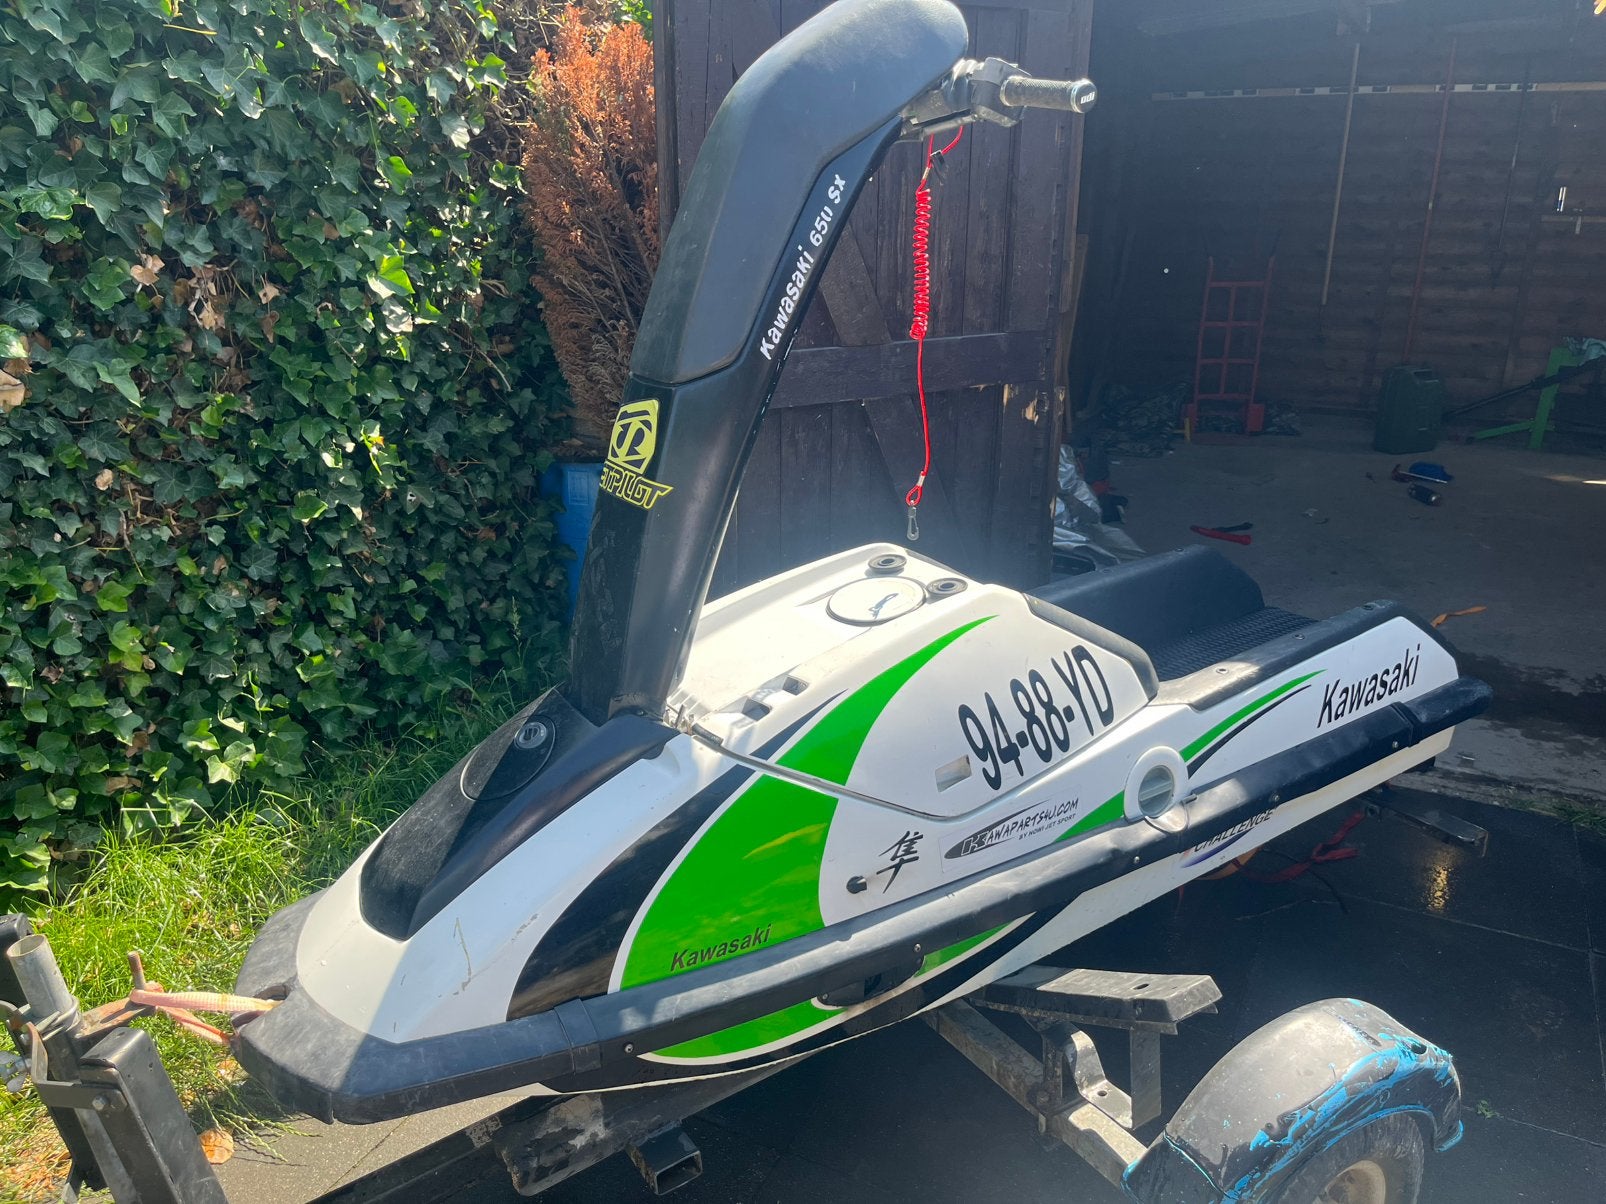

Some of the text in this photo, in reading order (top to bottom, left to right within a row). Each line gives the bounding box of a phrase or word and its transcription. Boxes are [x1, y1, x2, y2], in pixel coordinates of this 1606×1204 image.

[759, 244, 814, 360] Kawasaki
[809, 205, 833, 247] 650
[958, 644, 1115, 791] 94-88-YD
[1316, 643, 1421, 728] Kawasaki
[1056, 813, 1076, 825] SPORT
[670, 923, 773, 972] Kawasaki
